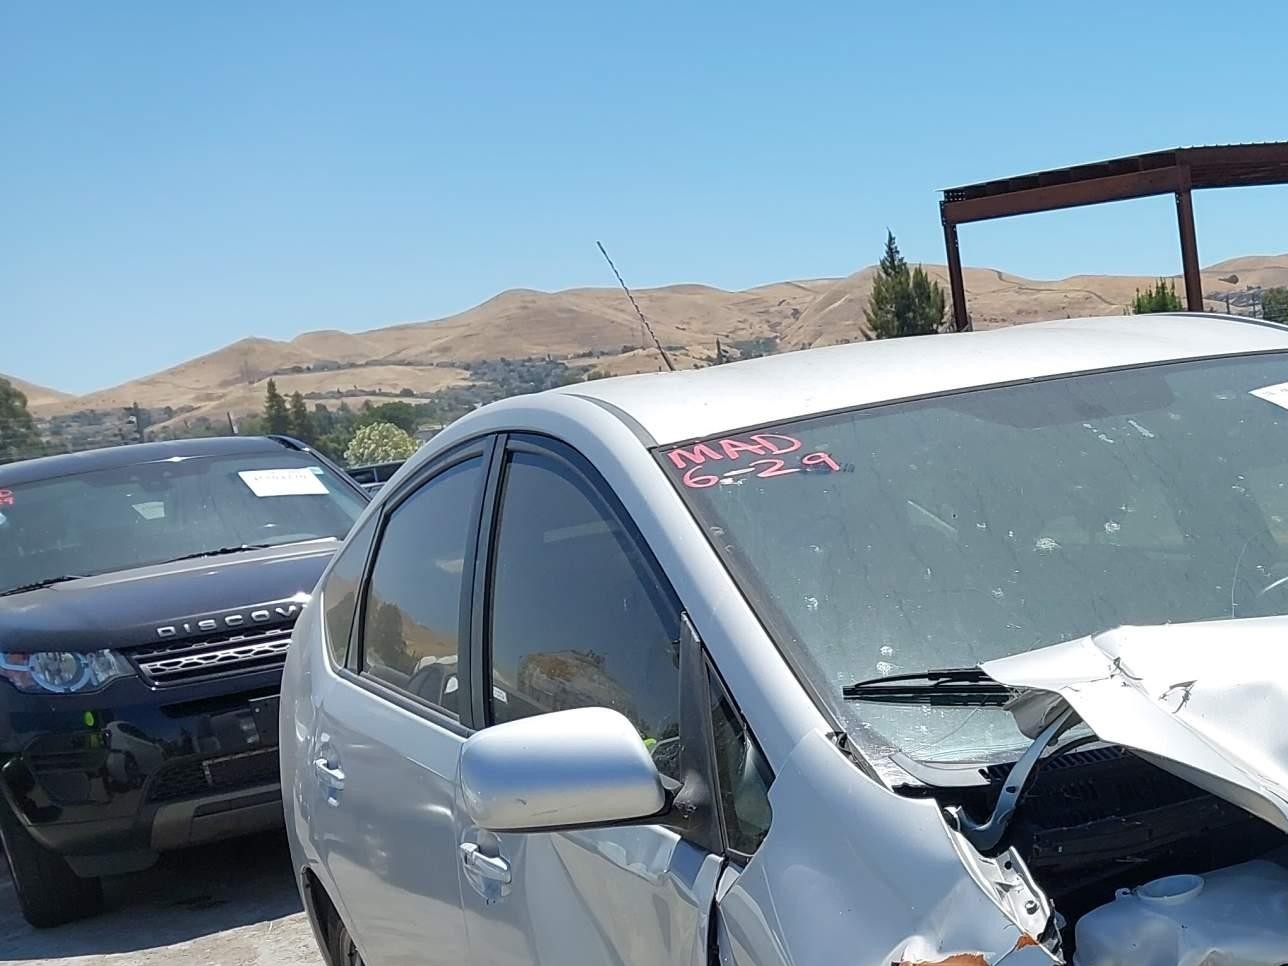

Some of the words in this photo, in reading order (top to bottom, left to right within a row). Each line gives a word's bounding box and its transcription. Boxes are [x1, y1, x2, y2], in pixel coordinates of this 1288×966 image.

[668, 434, 801, 468] MAD
[683, 452, 839, 487] 6-29
[157, 604, 307, 637] DISCOV
